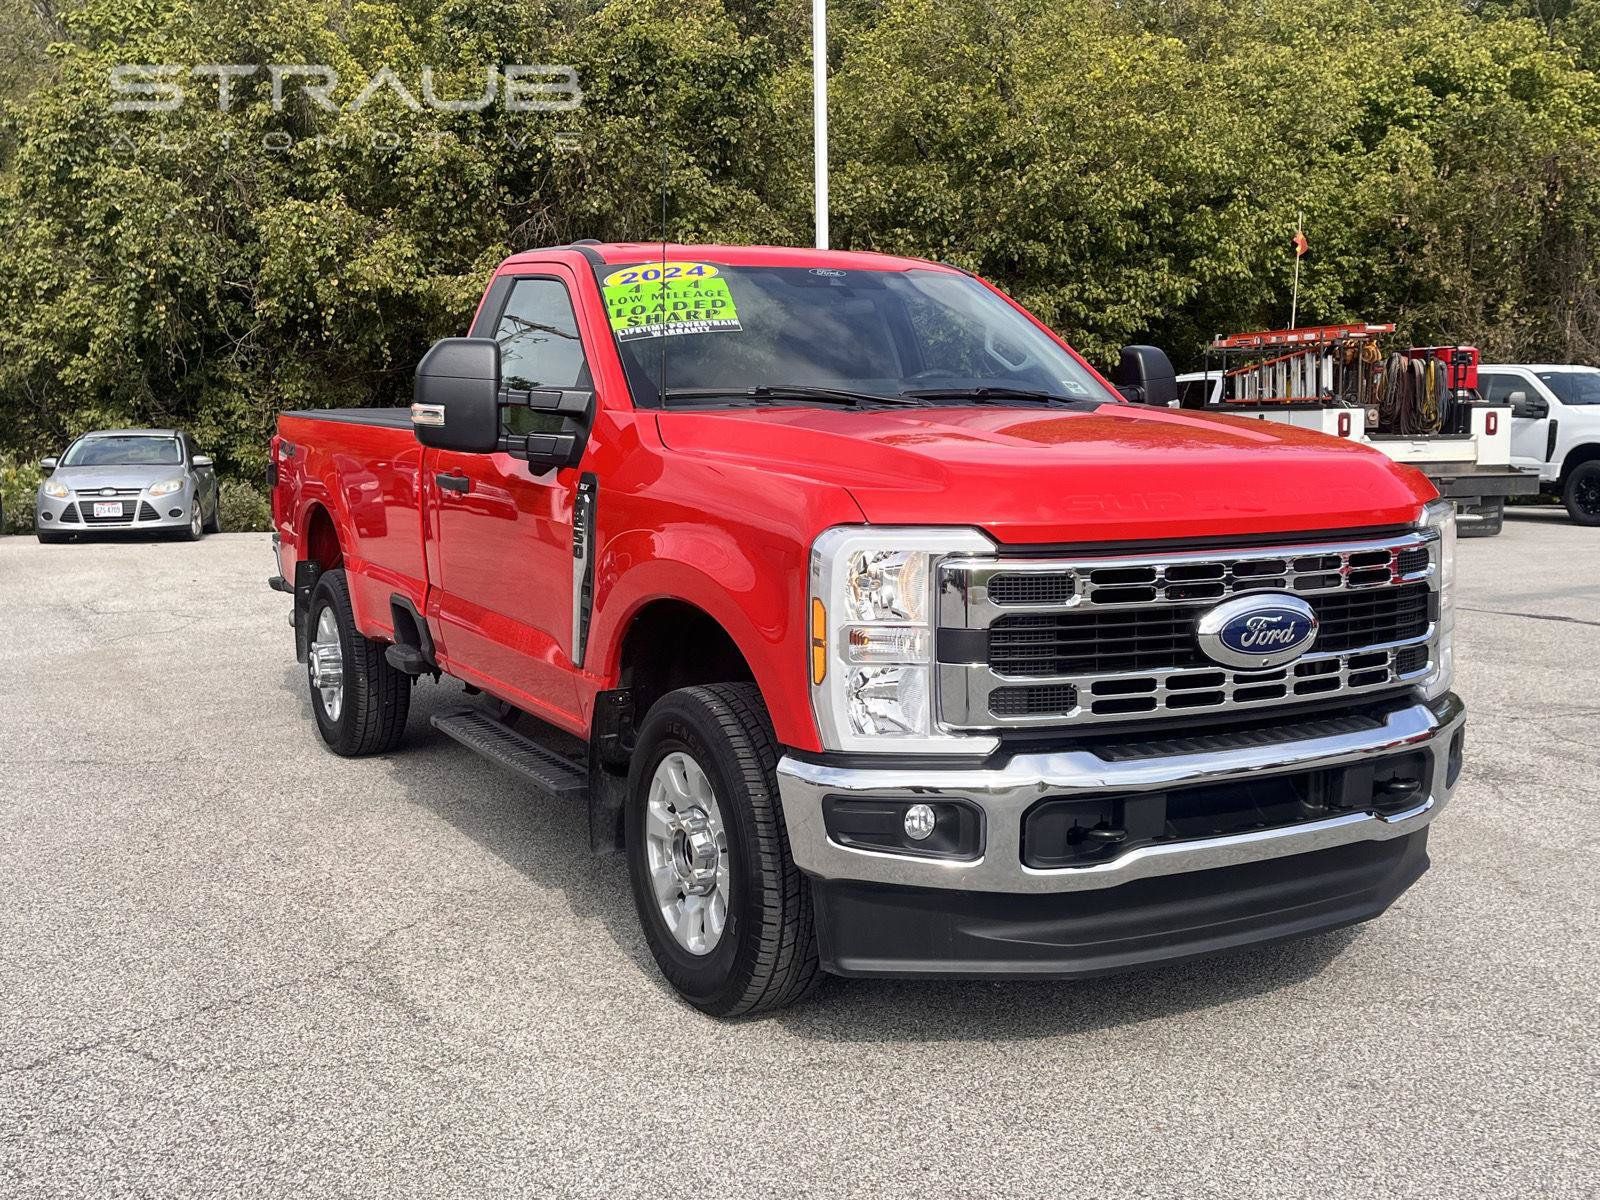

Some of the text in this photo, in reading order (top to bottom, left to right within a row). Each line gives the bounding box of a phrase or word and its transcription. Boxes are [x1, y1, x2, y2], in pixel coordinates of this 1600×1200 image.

[620, 265, 706, 285] 2024
[628, 284, 641, 294] 4
[688, 279, 700, 289] 4
[609, 289, 725, 306] LOW MILEAGE
[616, 299, 727, 318] LOADED
[626, 308, 721, 327] SHARP
[618, 319, 740, 336] LIFETIME POWERTRAIN
[651, 326, 711, 338] WARRANTY
[1241, 615, 1296, 648] Ford
